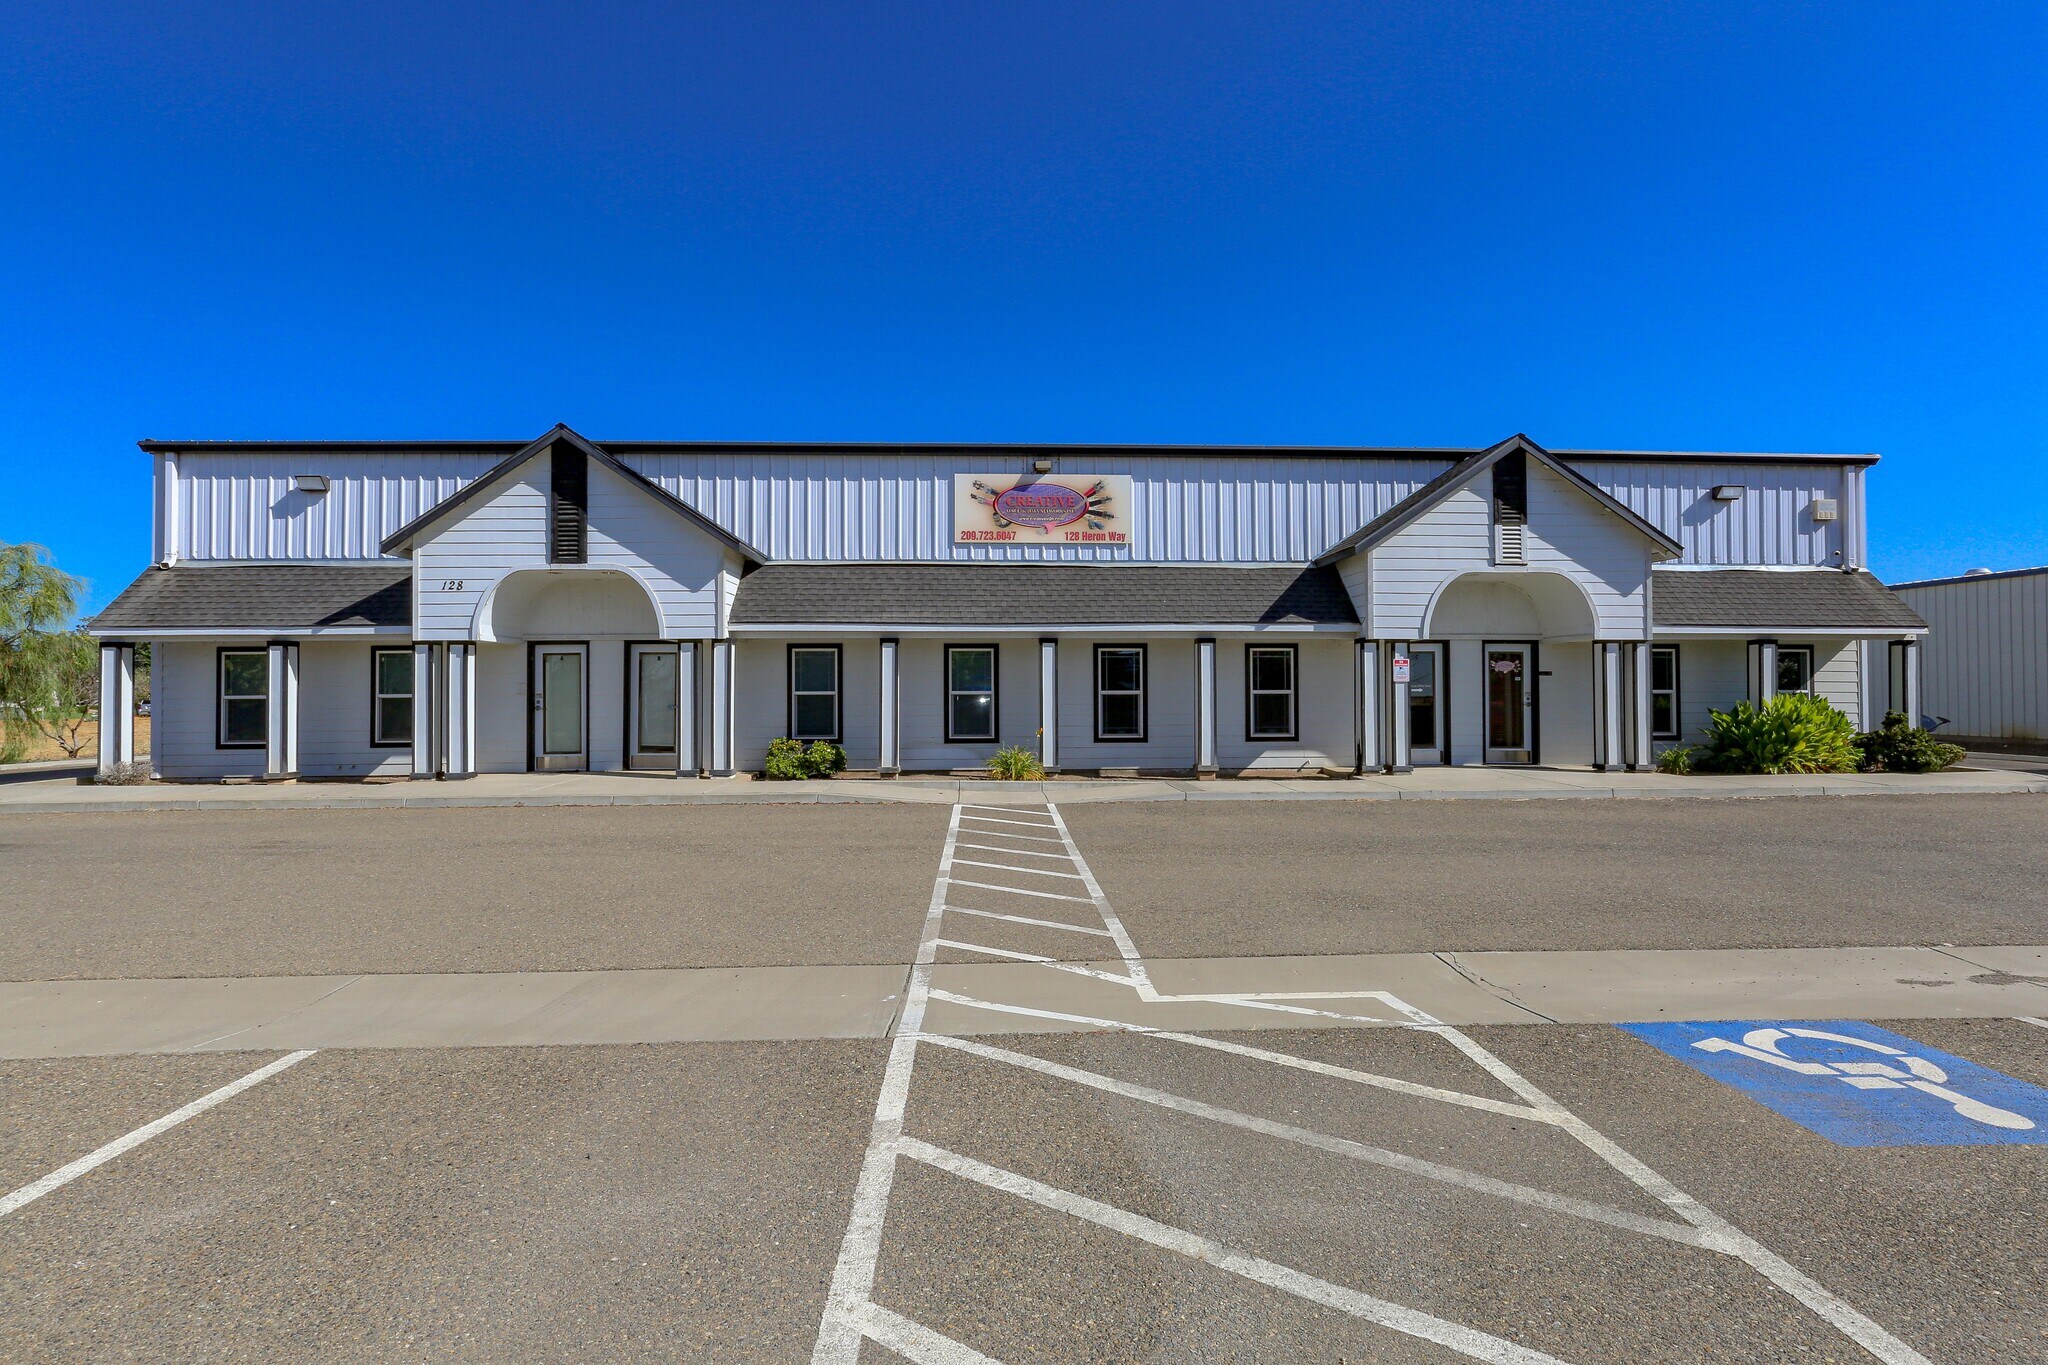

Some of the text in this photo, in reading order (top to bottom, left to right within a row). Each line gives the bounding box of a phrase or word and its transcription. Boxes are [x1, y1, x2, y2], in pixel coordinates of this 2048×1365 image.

[1006, 495, 1075, 507] CREATIVE
[960, 530, 1017, 541] 209.723.6047
[1064, 531, 1126, 542] 128 Heron Way
[441, 580, 463, 591] 128
